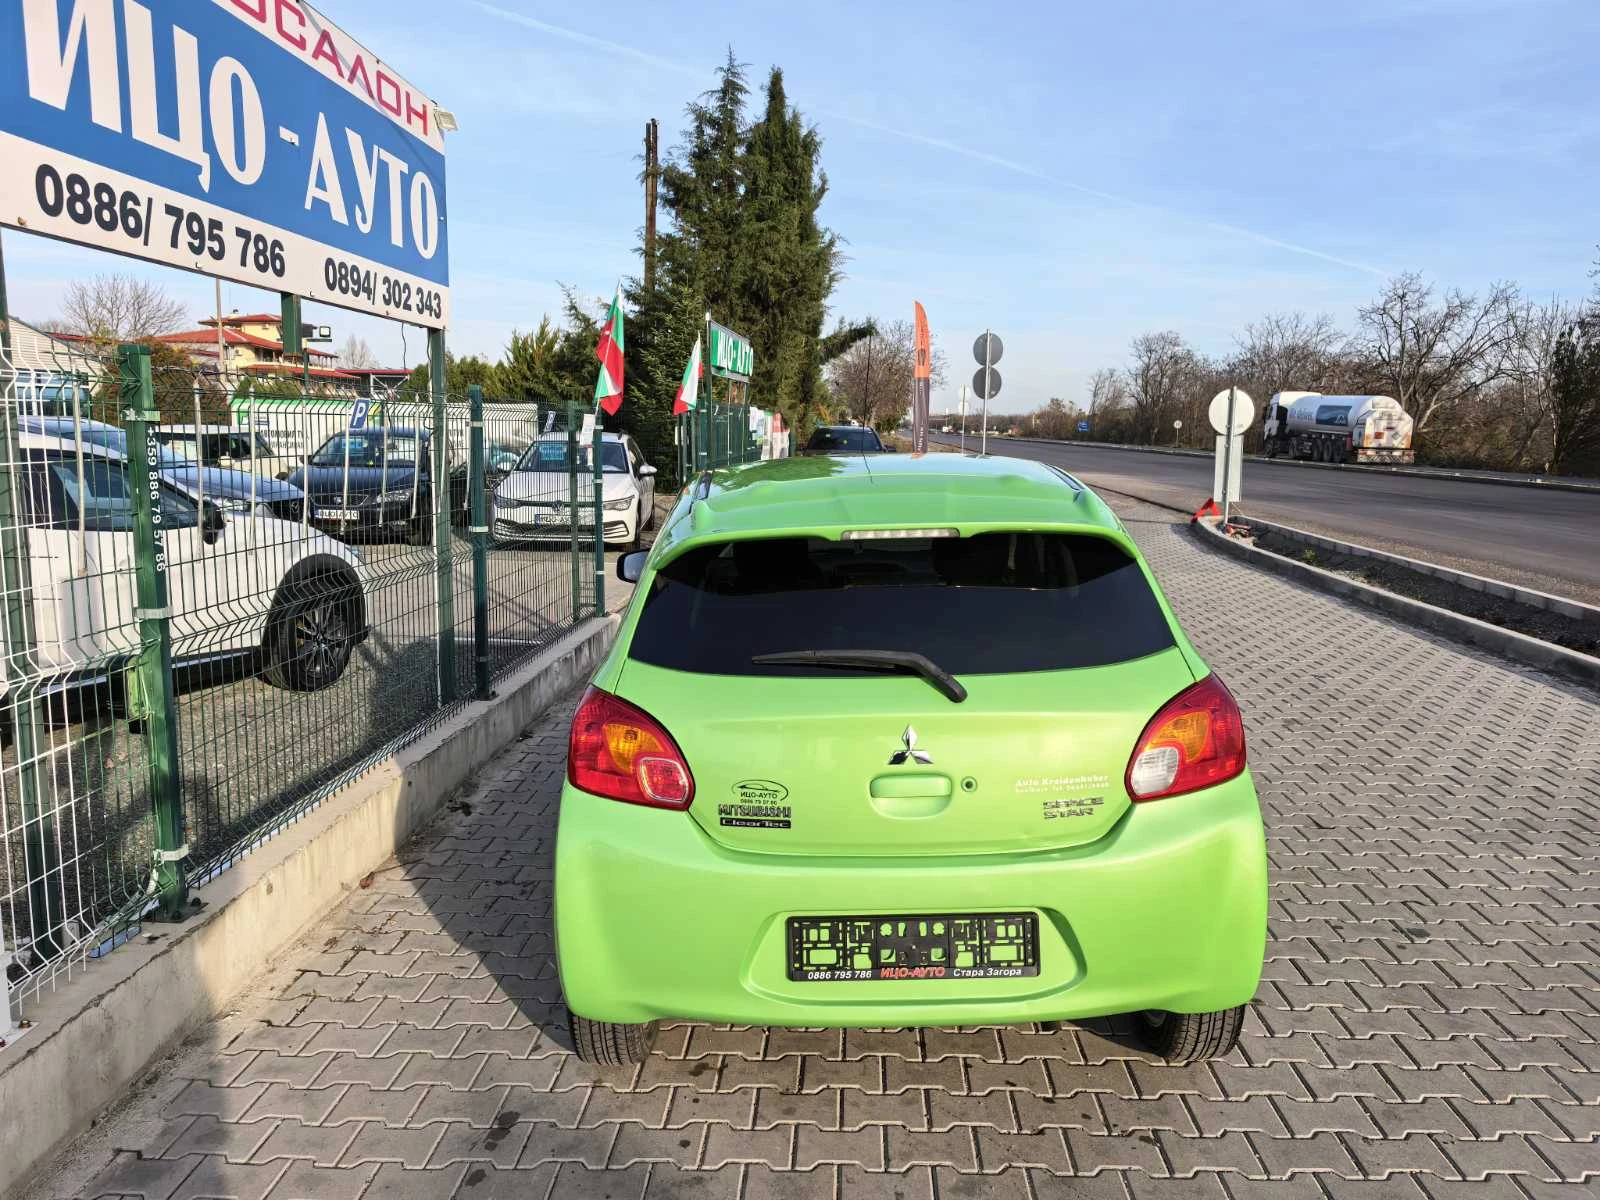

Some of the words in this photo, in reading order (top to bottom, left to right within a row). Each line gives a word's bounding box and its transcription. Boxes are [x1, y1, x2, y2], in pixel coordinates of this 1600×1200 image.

[35, 163, 153, 247] 0886/
[164, 204, 226, 261] 795
[235, 228, 286, 278] 786
[324, 257, 378, 306] 0894/
[382, 276, 412, 311] 302
[416, 287, 442, 320] 343
[146, 426, 157, 466] +359
[148, 471, 160, 500] 886
[151, 504, 162, 524] 79
[153, 529, 164, 547] 57
[155, 552, 166, 572] 86
[740, 791, 778, 799] ИЦО-АУТО
[718, 803, 791, 818] MITSUBISHI
[1044, 808, 1094, 820] STAR
[722, 818, 789, 828] ClearTec
[807, 971, 832, 980] 0886
[834, 971, 852, 979] 795
[854, 970, 872, 979] 786
[880, 966, 946, 980] ИЦО-АУТО
[953, 968, 984, 978] Стара
[986, 967, 1022, 978] Загора
